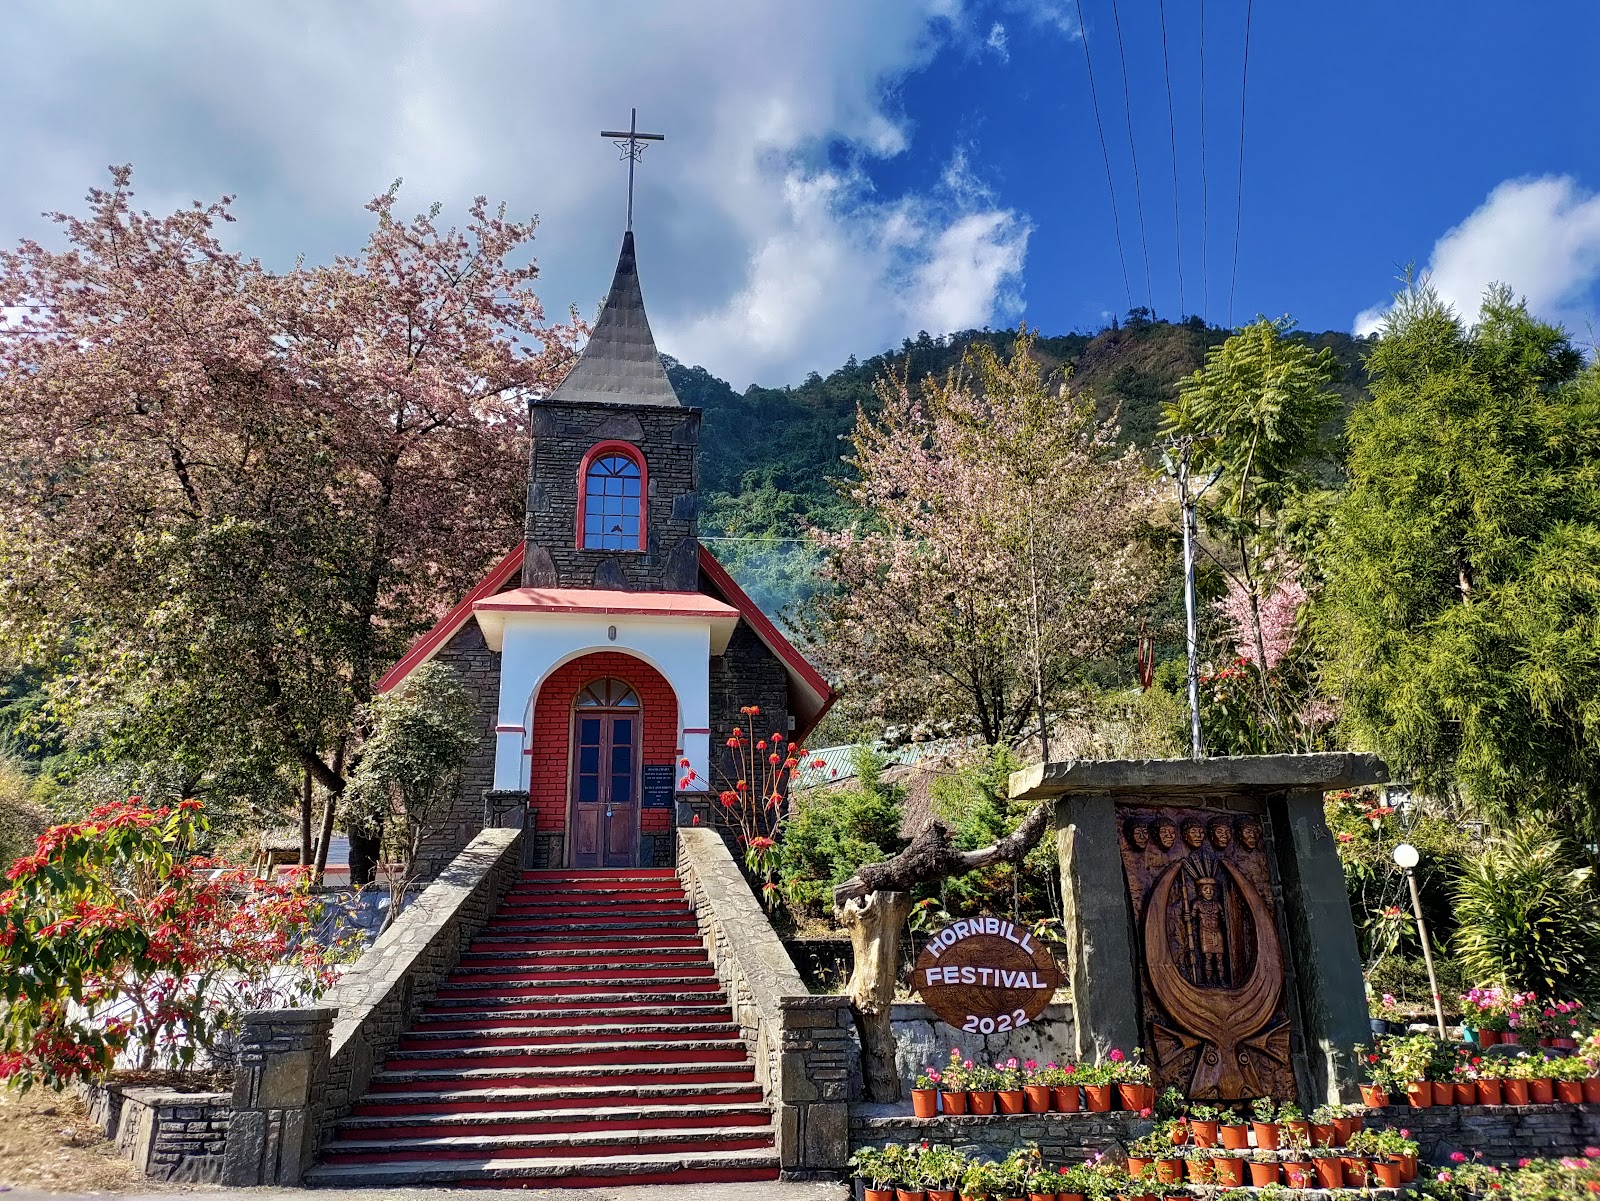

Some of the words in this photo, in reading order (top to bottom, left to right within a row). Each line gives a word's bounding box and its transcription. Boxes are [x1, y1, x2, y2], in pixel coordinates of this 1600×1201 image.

[925, 917, 1034, 959] HORNBILL
[925, 966, 1047, 989] FESTIVAL
[962, 1009, 1030, 1034] 2022
